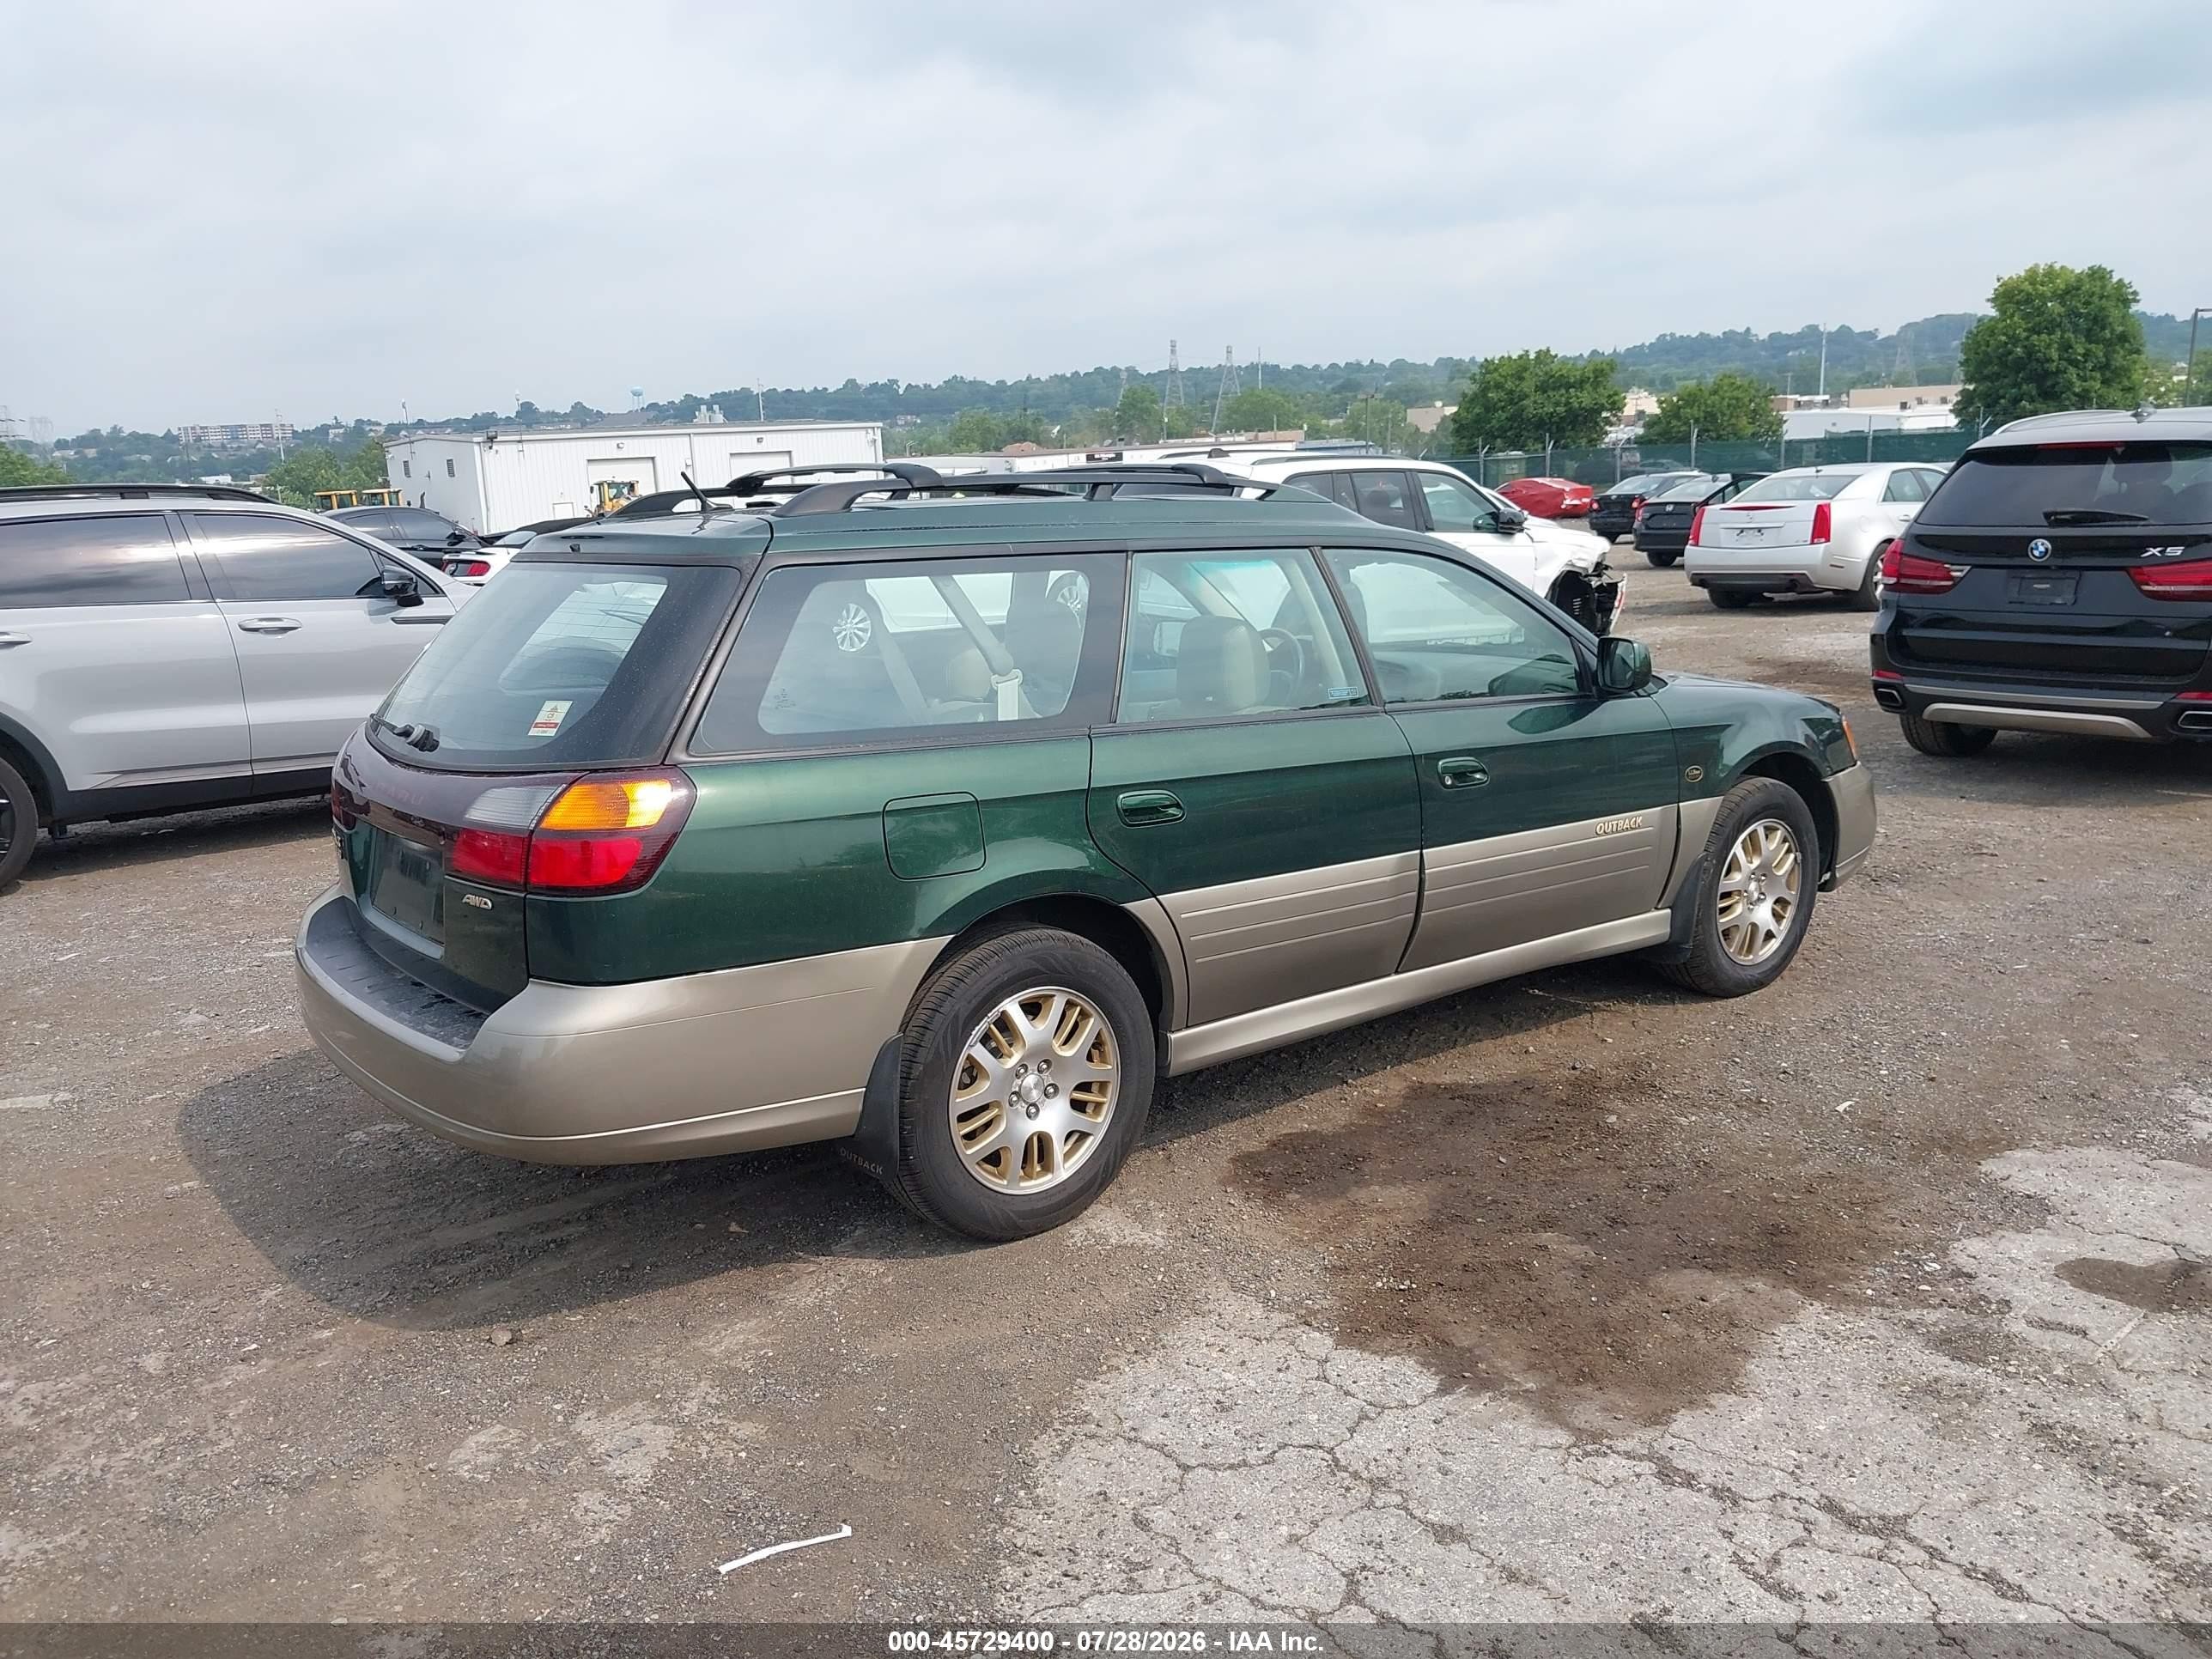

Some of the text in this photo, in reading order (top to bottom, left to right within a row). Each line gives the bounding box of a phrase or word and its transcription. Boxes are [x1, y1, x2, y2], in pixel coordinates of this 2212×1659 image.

[2141, 546, 2185, 557] X5
[1595, 816, 1643, 836] OUTBACK
[462, 894, 493, 910] AWD
[839, 1146, 884, 1176] OUTBACK
